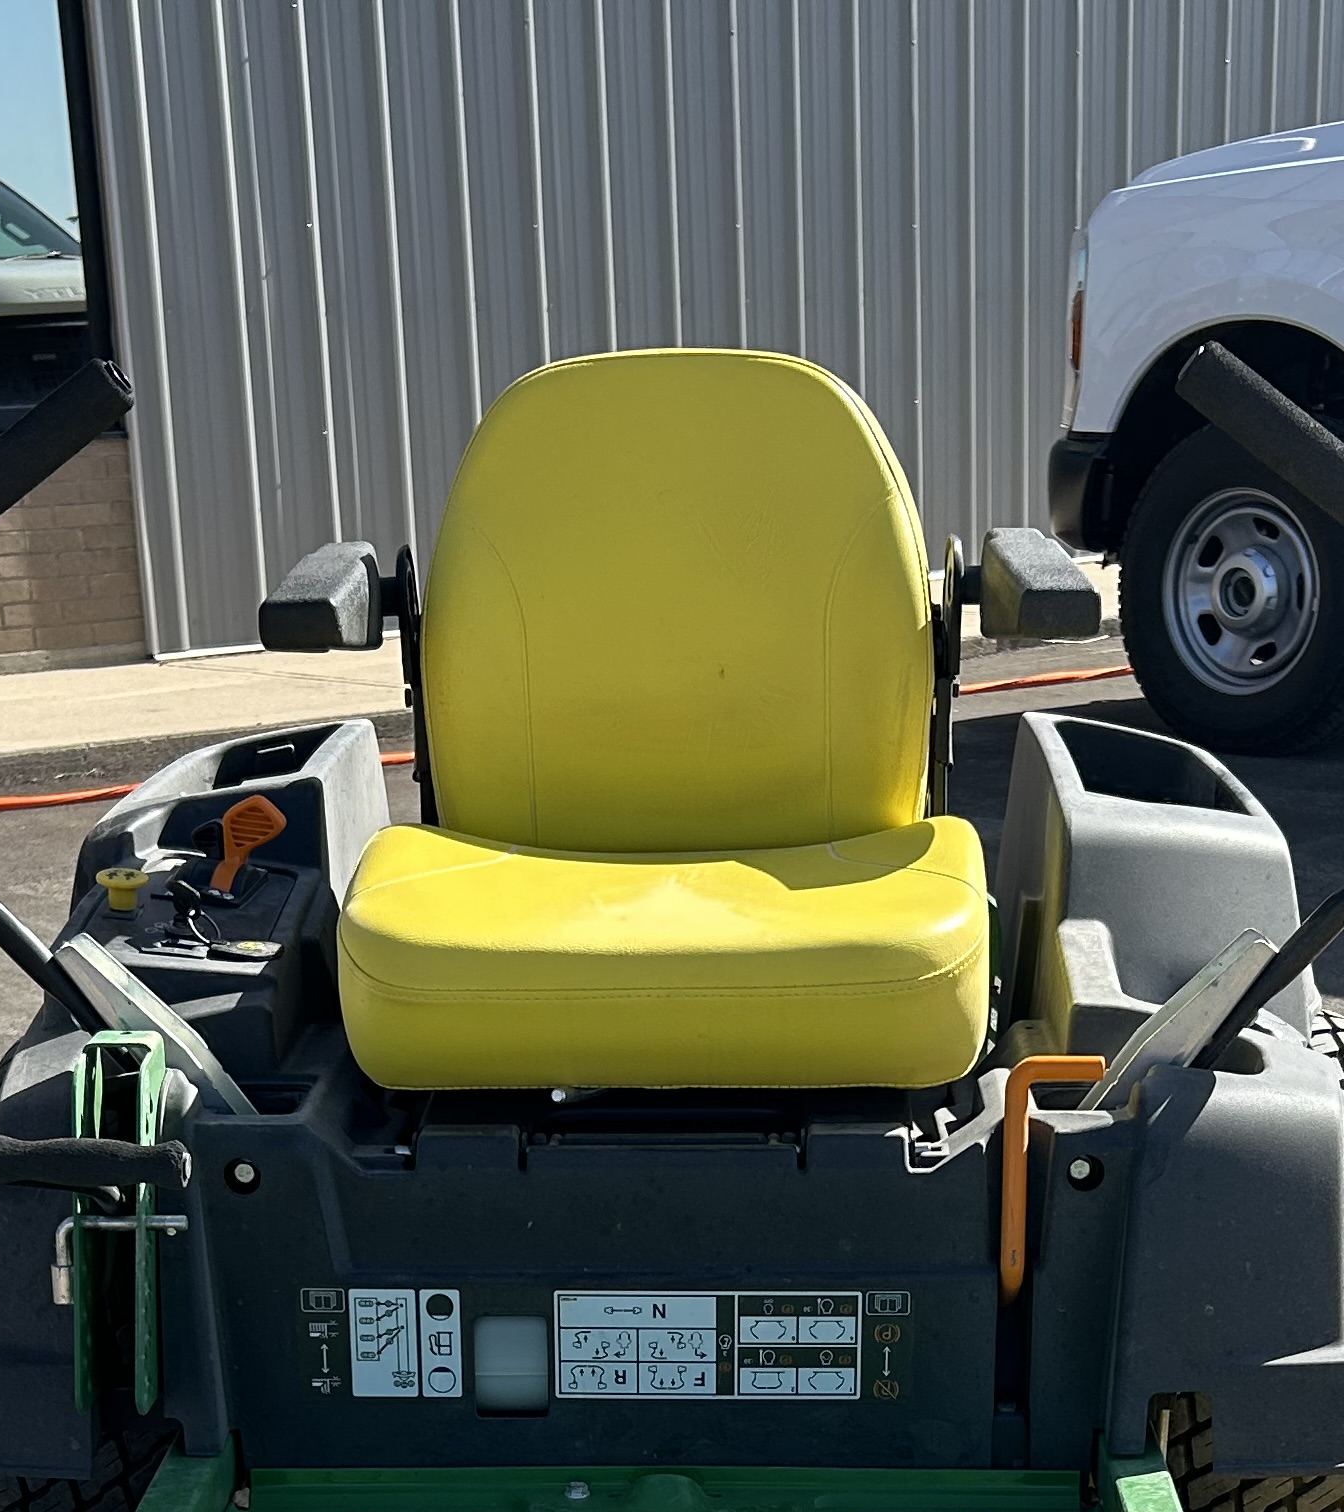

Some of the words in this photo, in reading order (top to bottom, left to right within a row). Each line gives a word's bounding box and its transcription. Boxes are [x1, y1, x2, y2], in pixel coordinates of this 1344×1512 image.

[652, 1303, 666, 1319] N
[614, 1369, 627, 1385] R
[693, 1371, 706, 1387] F
